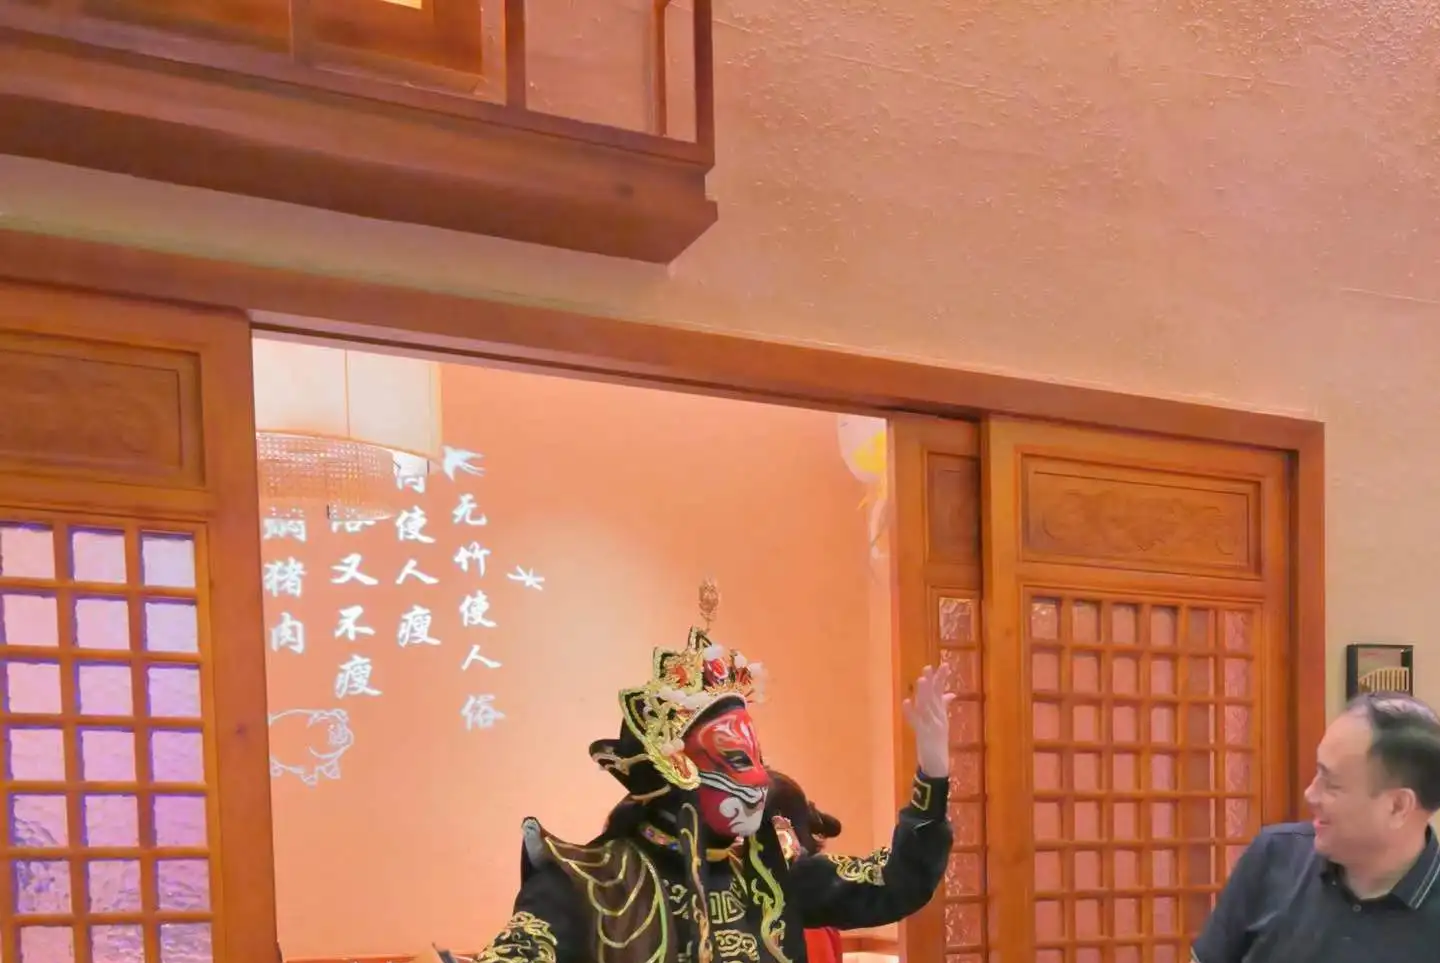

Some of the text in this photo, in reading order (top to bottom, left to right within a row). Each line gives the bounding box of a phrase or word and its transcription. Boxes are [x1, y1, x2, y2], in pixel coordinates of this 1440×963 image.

[453, 493, 506, 731] 无竹使人俗
